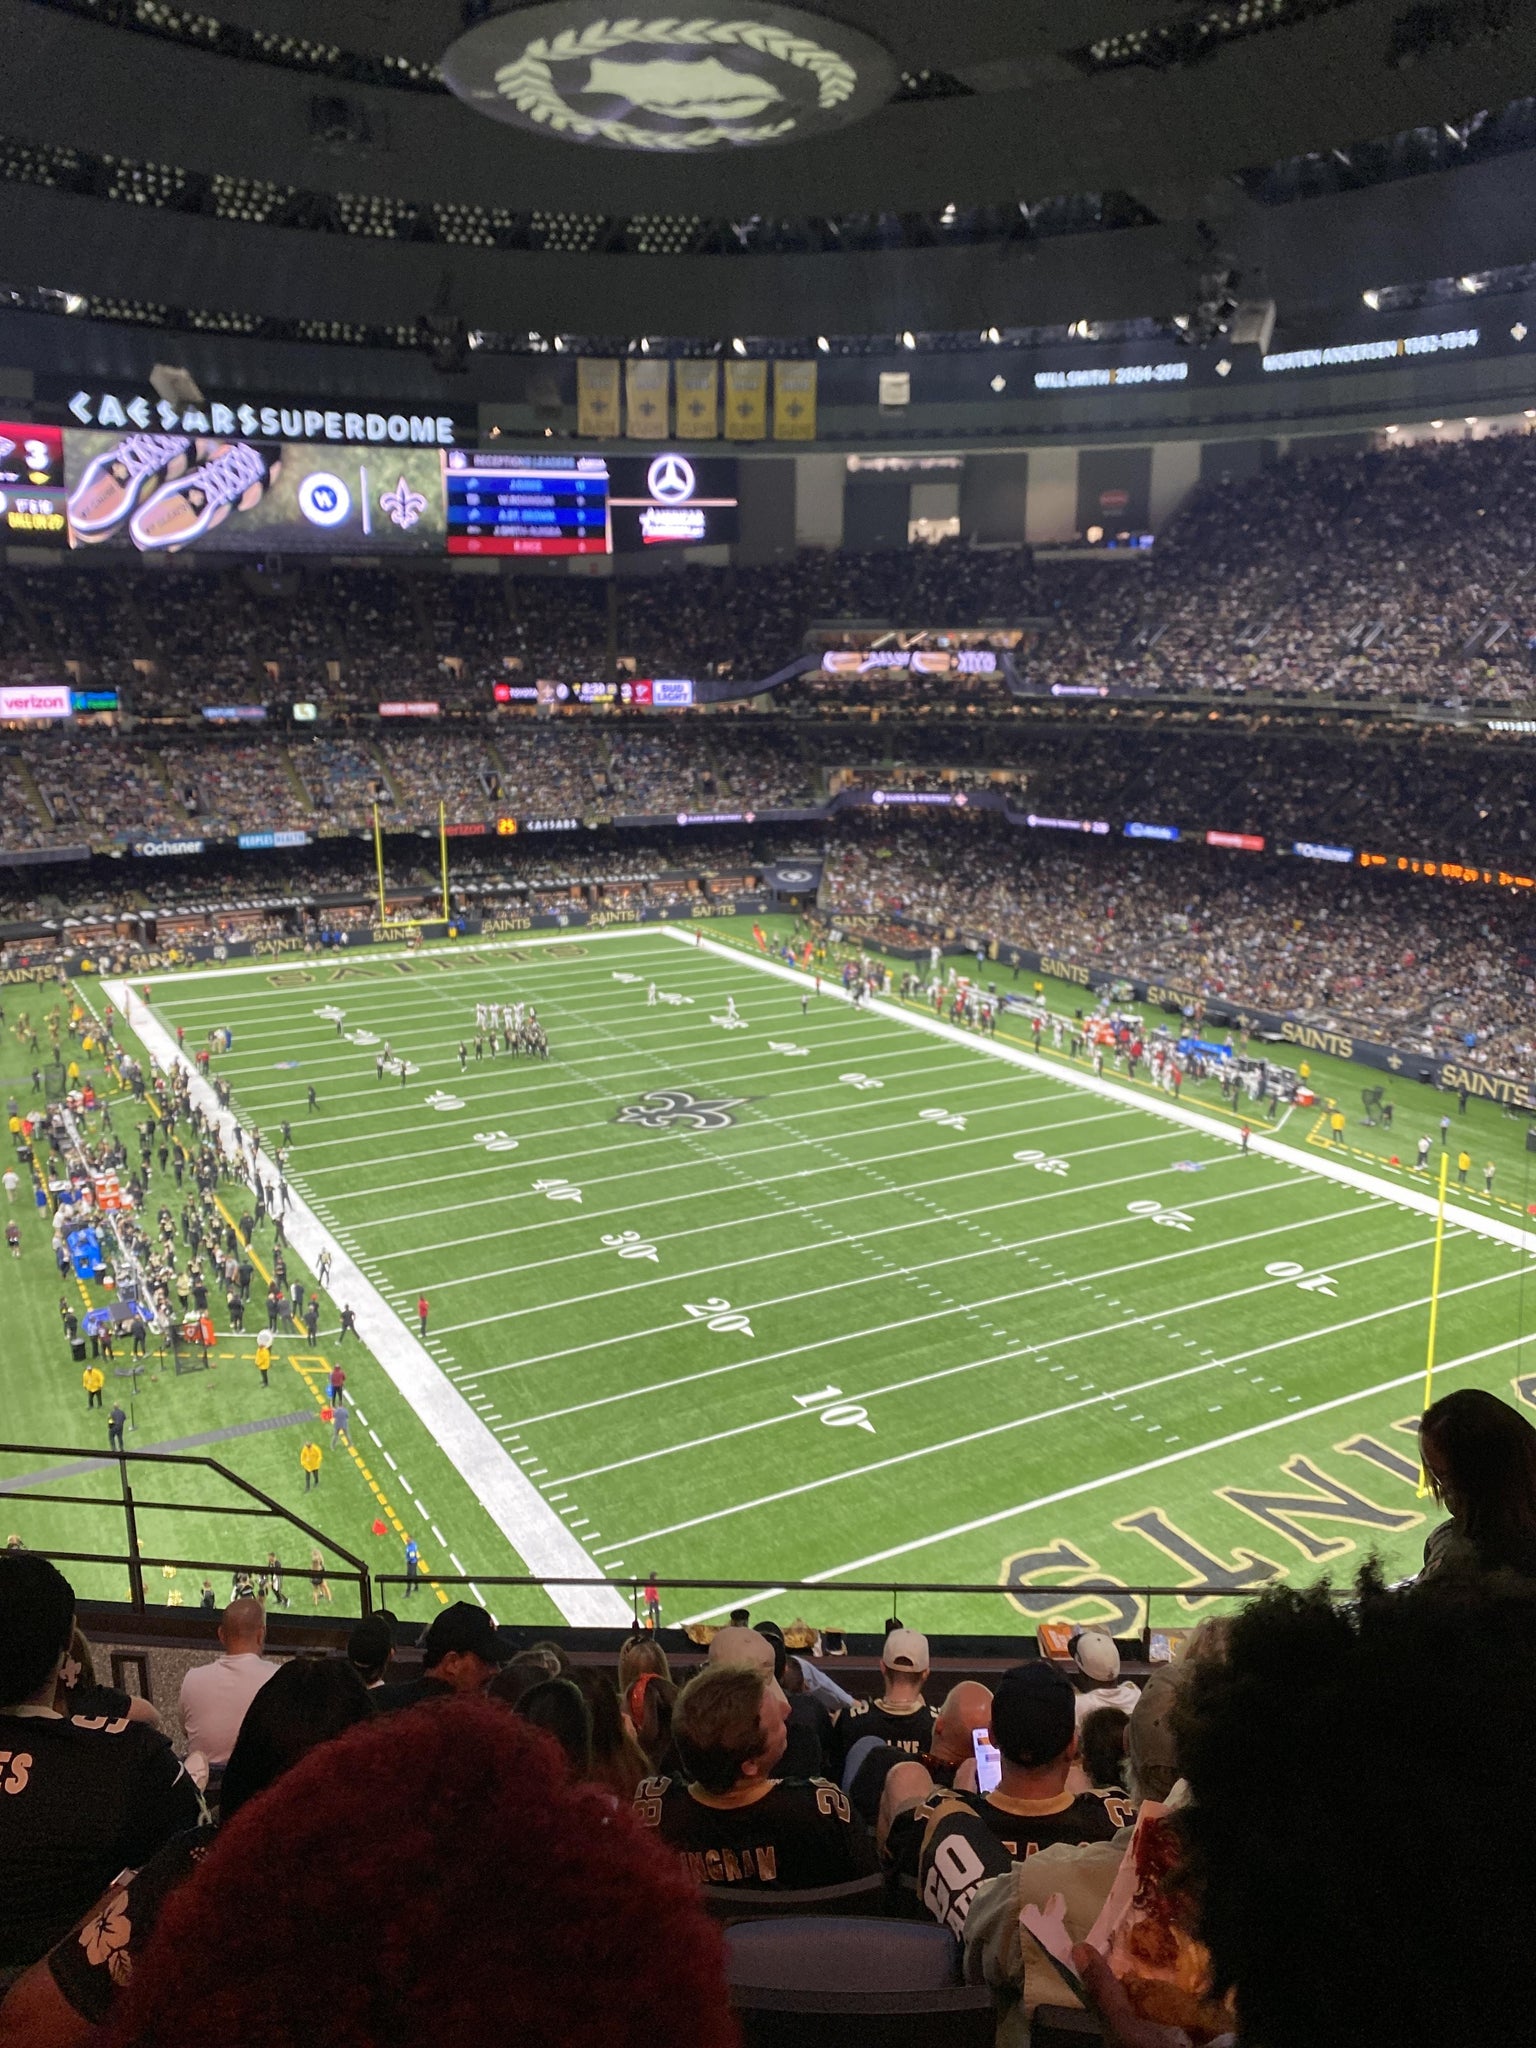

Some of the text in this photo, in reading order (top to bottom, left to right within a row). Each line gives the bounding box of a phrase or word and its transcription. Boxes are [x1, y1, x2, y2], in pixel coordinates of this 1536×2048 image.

[68, 390, 455, 444] CAESARS SUPERDOME
[24, 439, 49, 470] 3
[657, 691, 688, 701] LIGHT
[660, 683, 685, 692] BUD
[5, 694, 64, 711] verizon
[526, 819, 578, 832] CAESARS
[143, 840, 201, 855] Ochsner
[175, 895, 315, 915] SUPERDOME
[590, 909, 636, 926] SAINTS
[483, 916, 531, 932] SAINTS
[1040, 956, 1090, 985] SAINTS
[1281, 1021, 1354, 1059] SAINTS
[1442, 1064, 1531, 1105] SAINTS
[531, 1178, 583, 1201] 40
[600, 1230, 658, 1259] 30
[681, 1297, 751, 1332] 20
[791, 1384, 869, 1427] 10
[679, 1845, 777, 1882] INGRAM
